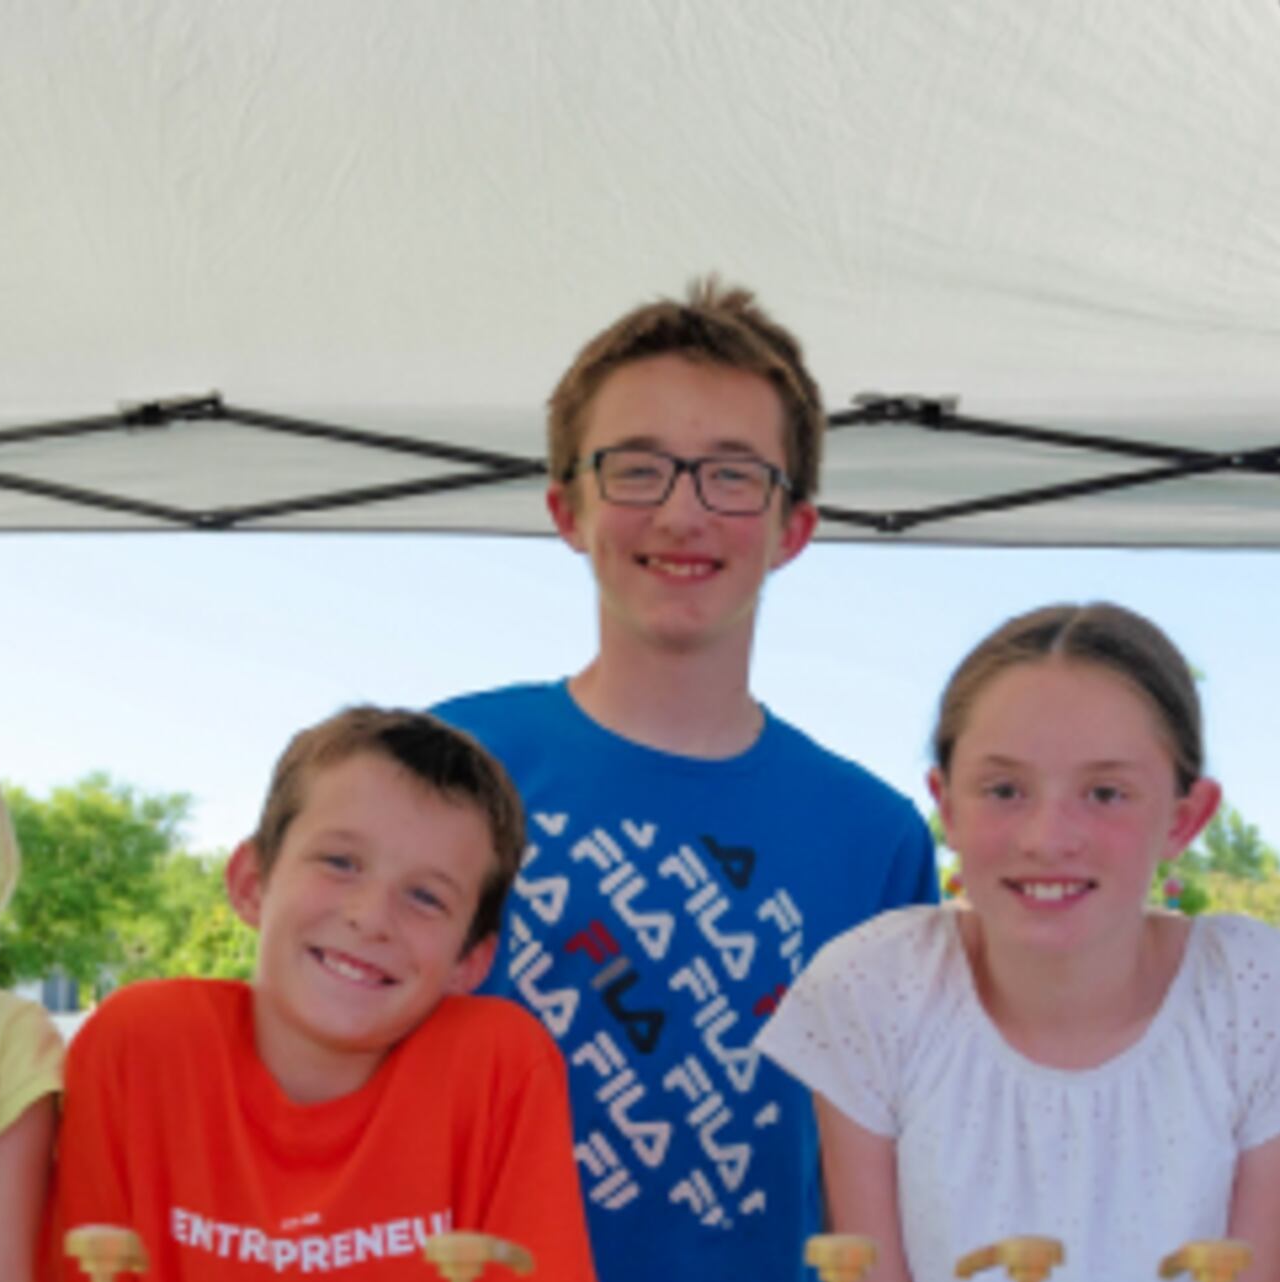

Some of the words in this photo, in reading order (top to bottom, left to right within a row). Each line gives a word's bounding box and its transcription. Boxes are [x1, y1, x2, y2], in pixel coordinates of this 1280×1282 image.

[570, 827, 675, 961] FILA
[658, 844, 756, 981] FILA
[563, 919, 666, 1055] FILA
[668, 957, 761, 1093] FILA
[572, 1031, 673, 1169] FILA
[662, 1055, 751, 1192] FILA
